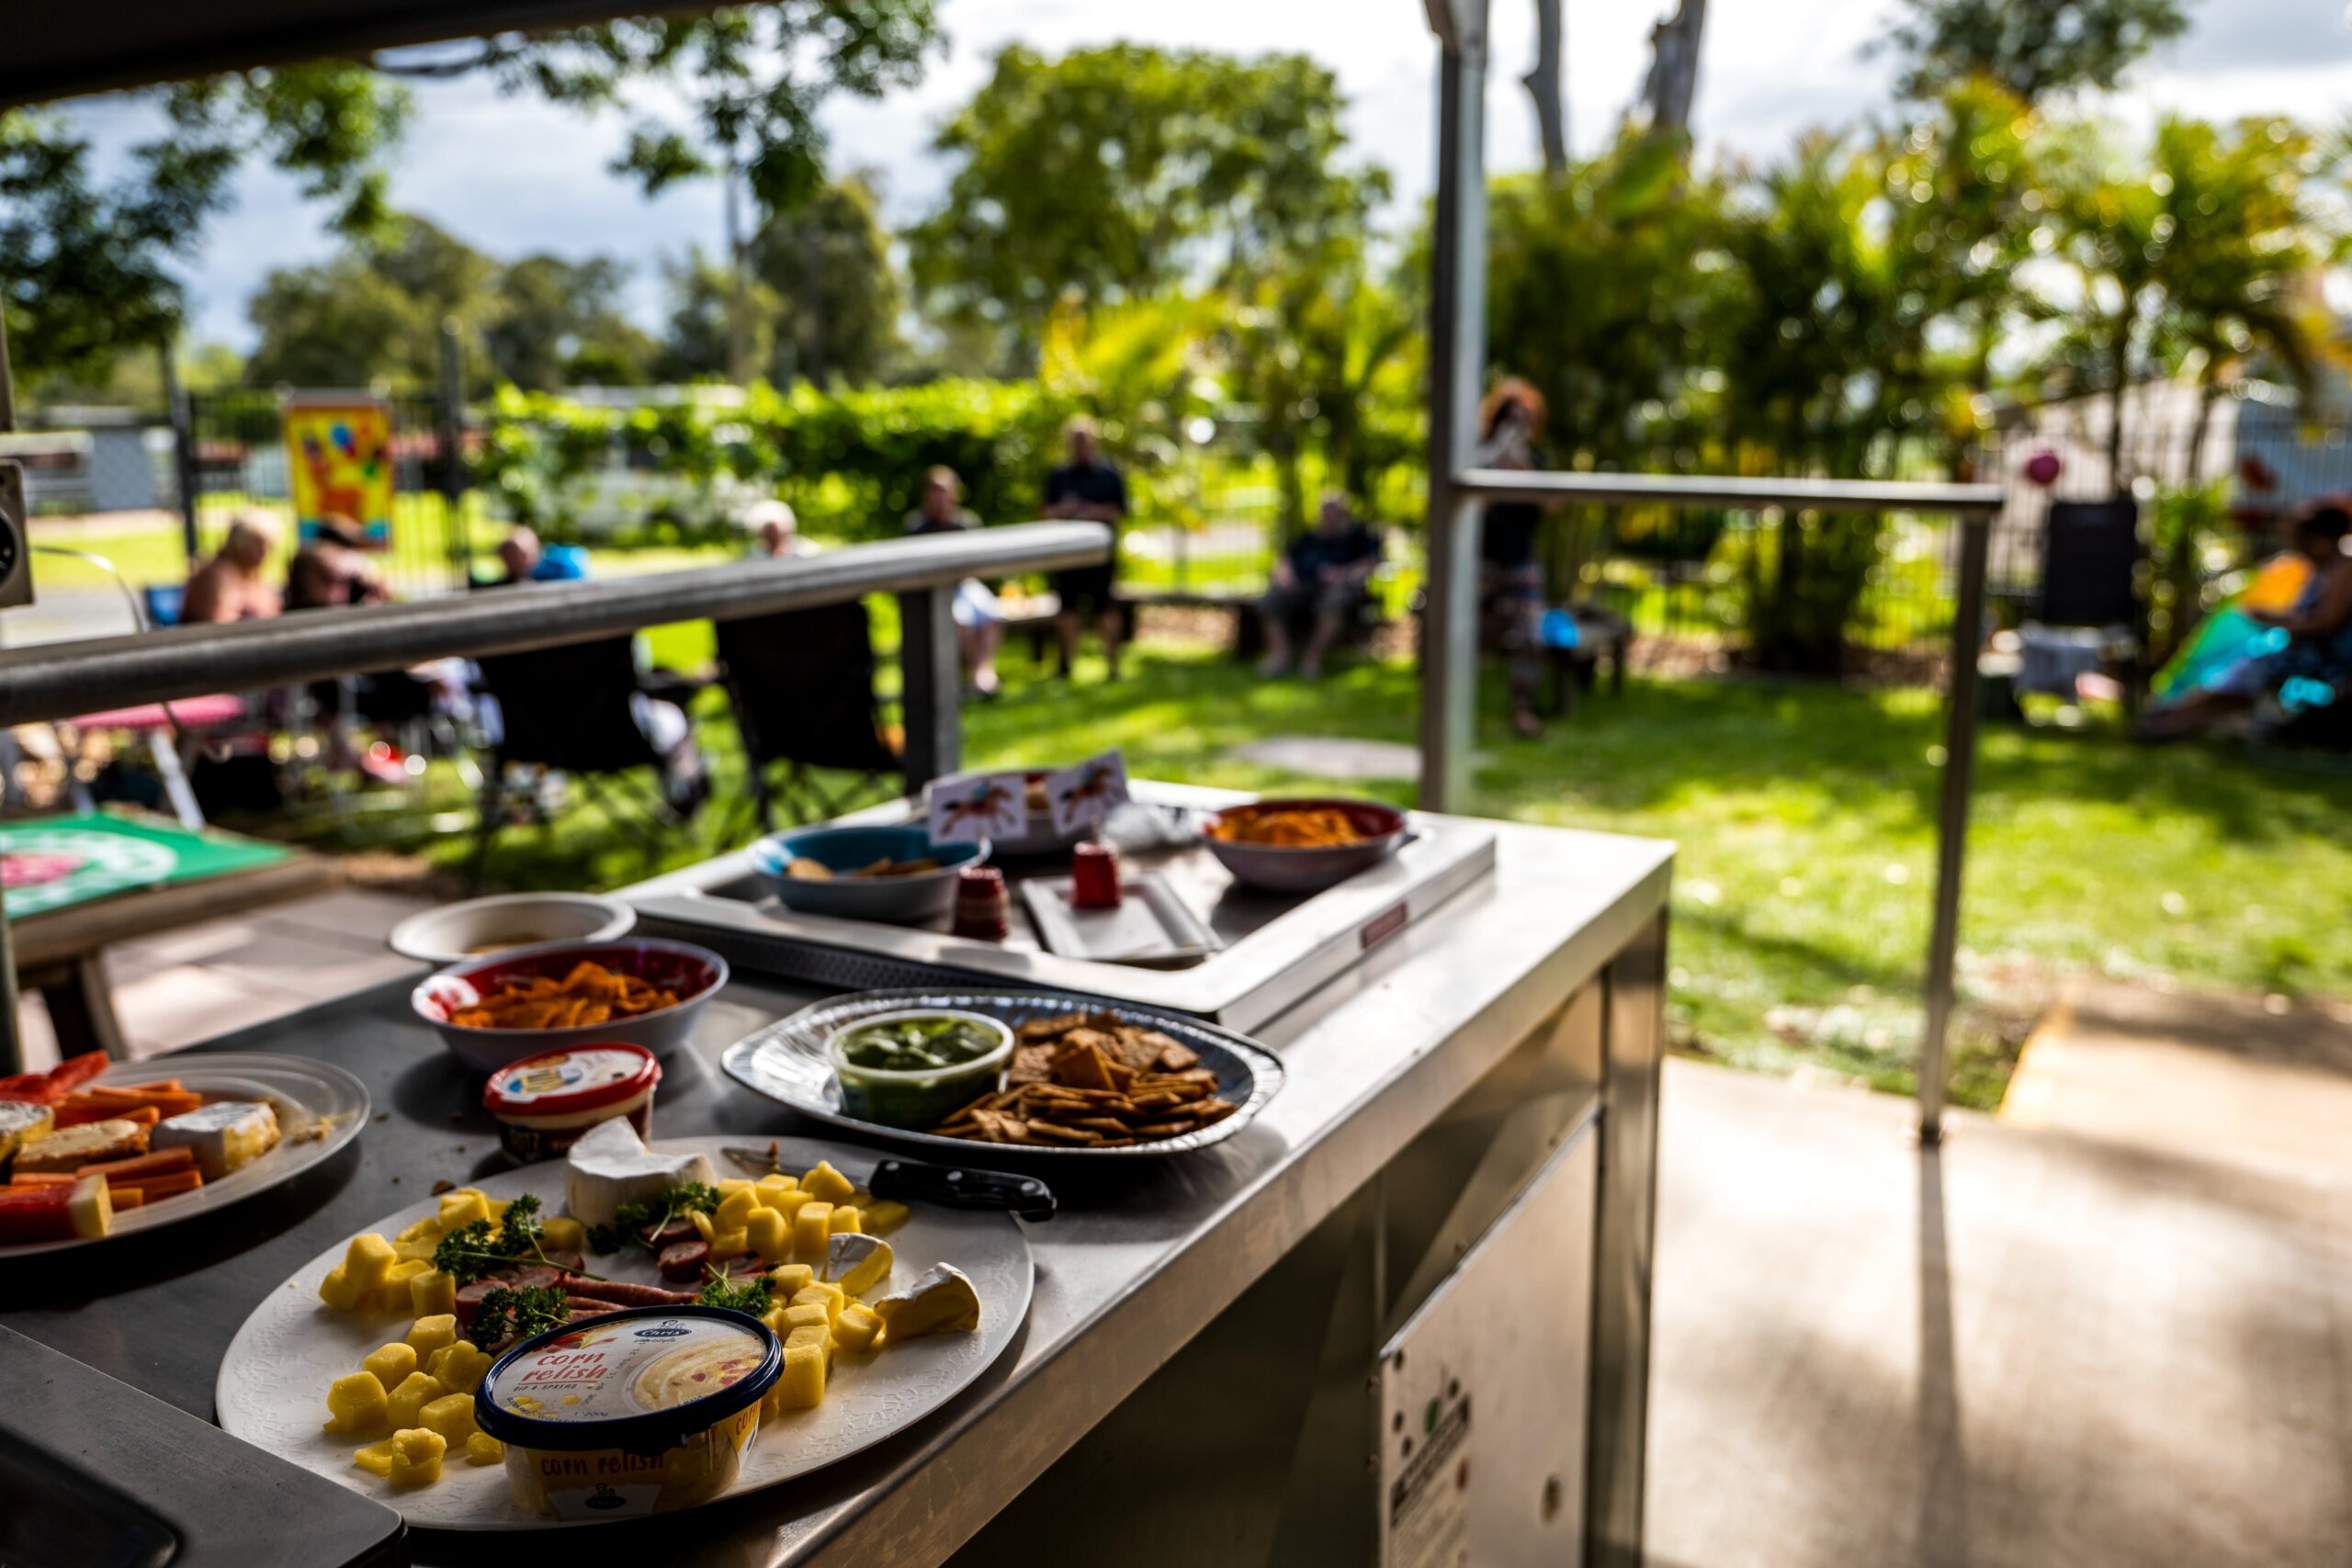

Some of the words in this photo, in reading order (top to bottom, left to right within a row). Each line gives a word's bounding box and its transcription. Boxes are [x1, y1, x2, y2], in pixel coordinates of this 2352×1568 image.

[537, 1352, 606, 1366] corn
[521, 1363, 609, 1382] relish
[540, 1457, 589, 1476] corn
[598, 1453, 664, 1474] relish
